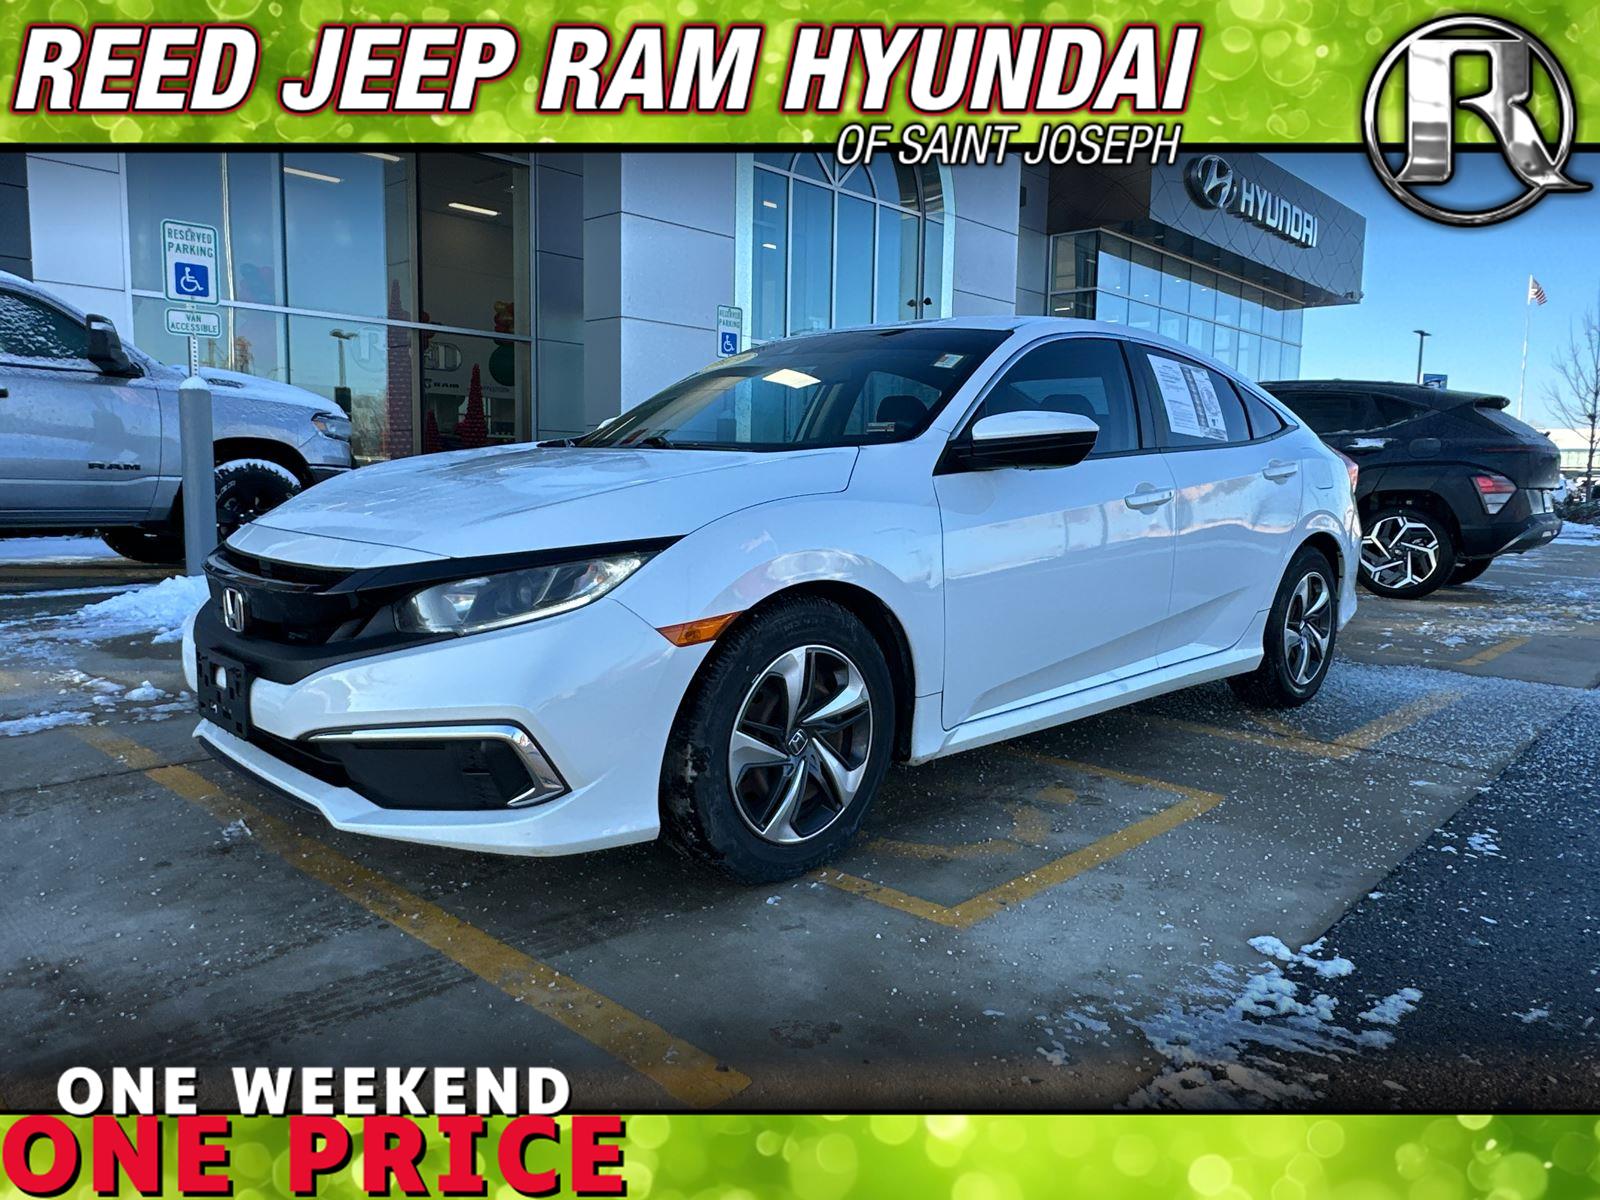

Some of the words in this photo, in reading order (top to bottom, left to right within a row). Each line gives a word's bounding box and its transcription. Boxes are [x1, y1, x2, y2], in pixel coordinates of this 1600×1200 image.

[1240, 177, 1318, 248] HYUNDAI
[167, 227, 212, 244] RESERVED
[168, 242, 214, 258] PARKING
[186, 314, 202, 323] VAN
[170, 321, 217, 333] ACCESSIBLE
[88, 462, 141, 470] RAM
